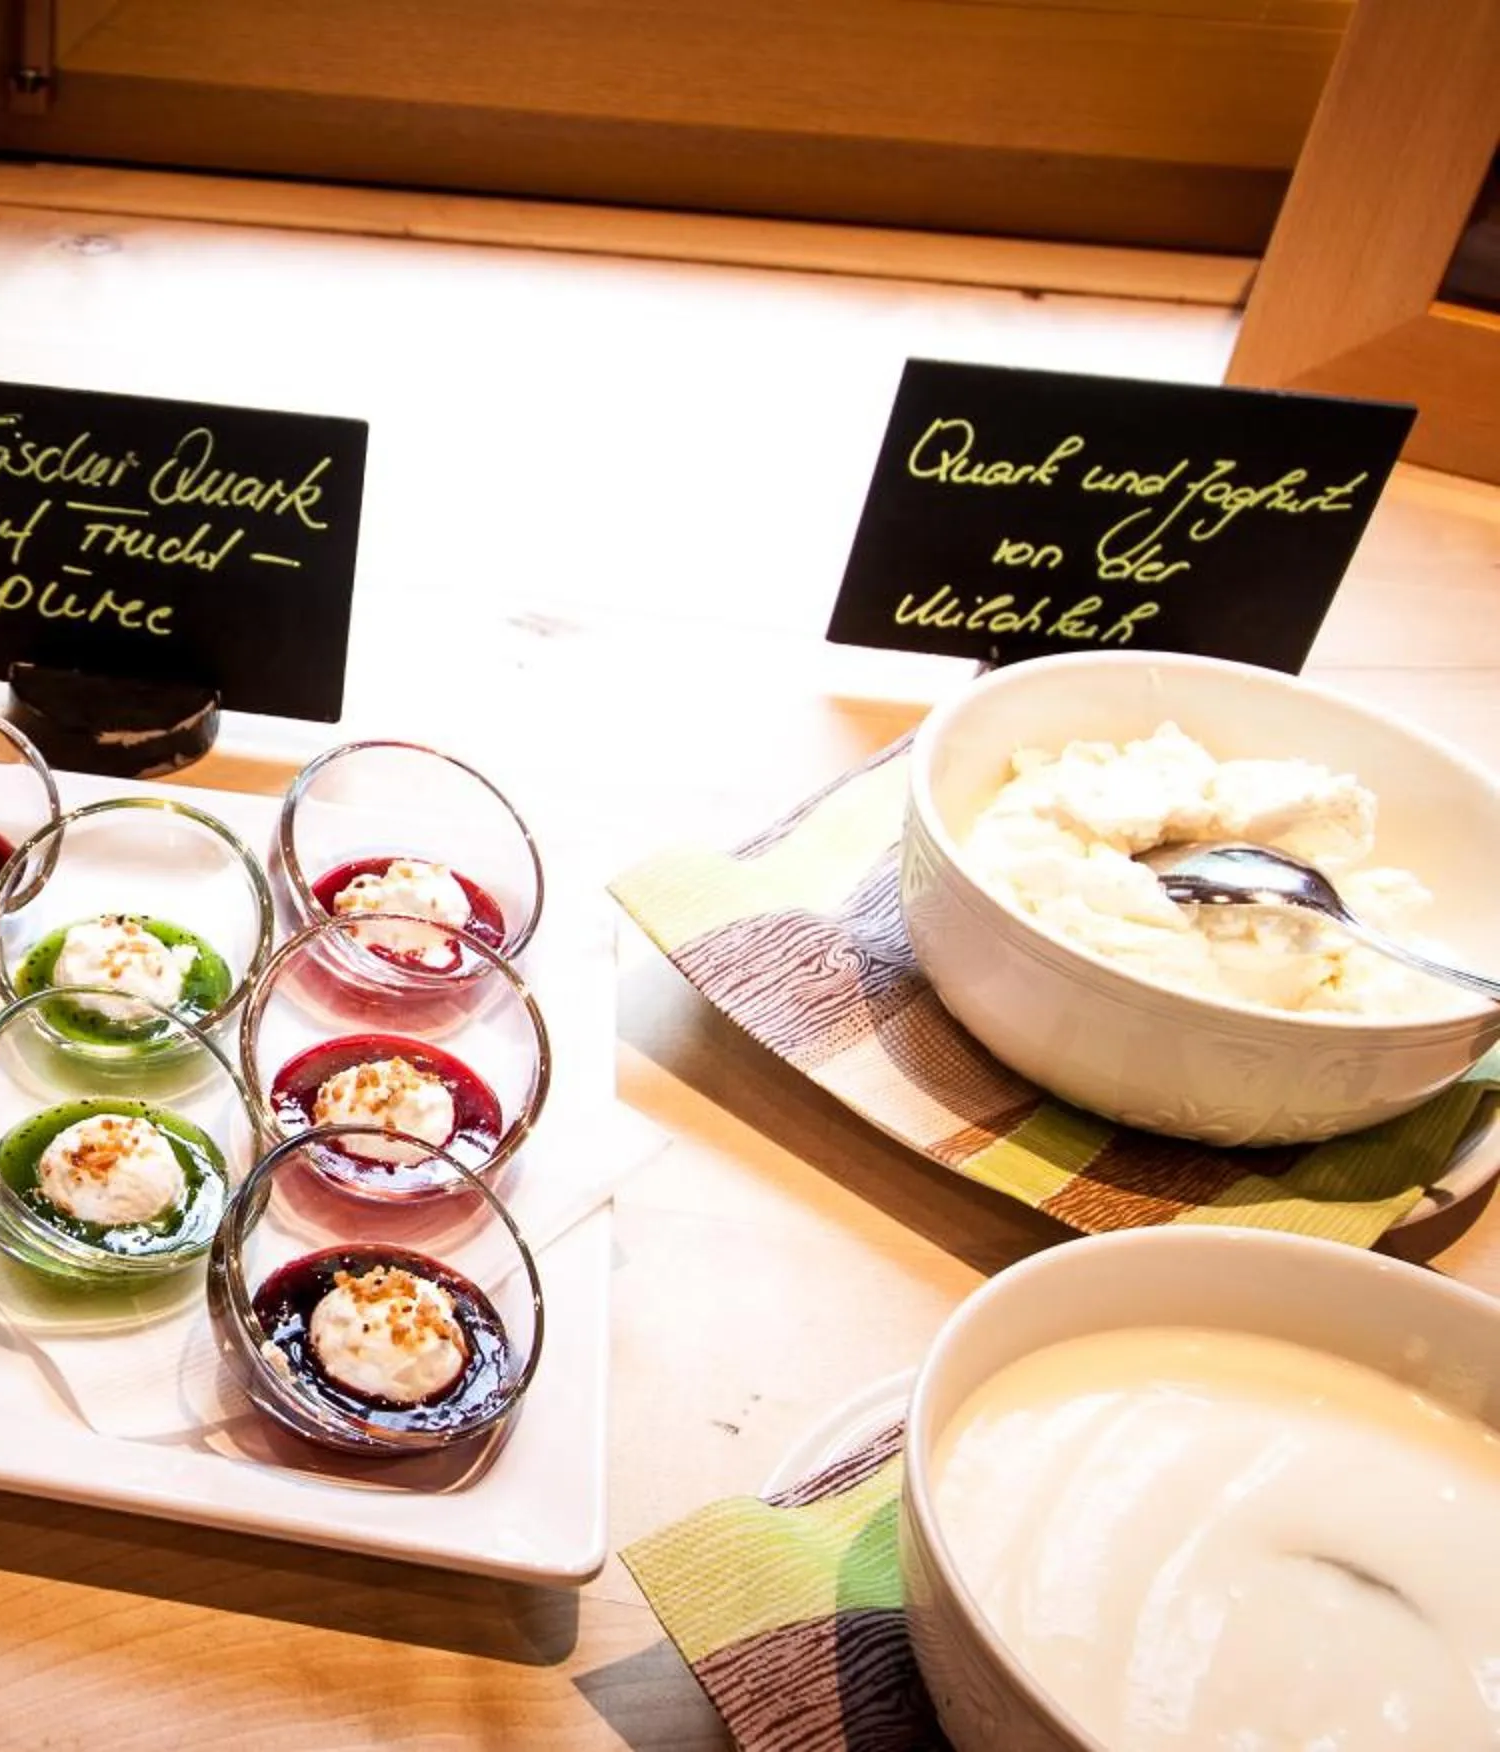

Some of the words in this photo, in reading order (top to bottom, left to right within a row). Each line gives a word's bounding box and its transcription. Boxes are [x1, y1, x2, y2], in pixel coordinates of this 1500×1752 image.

[149, 427, 332, 530] Quark
[906, 418, 1085, 485] Quark
[1082, 458, 1190, 497] und
[1097, 458, 1368, 561] Joghurt
[991, 536, 1065, 570] von
[1097, 541, 1191, 584] der
